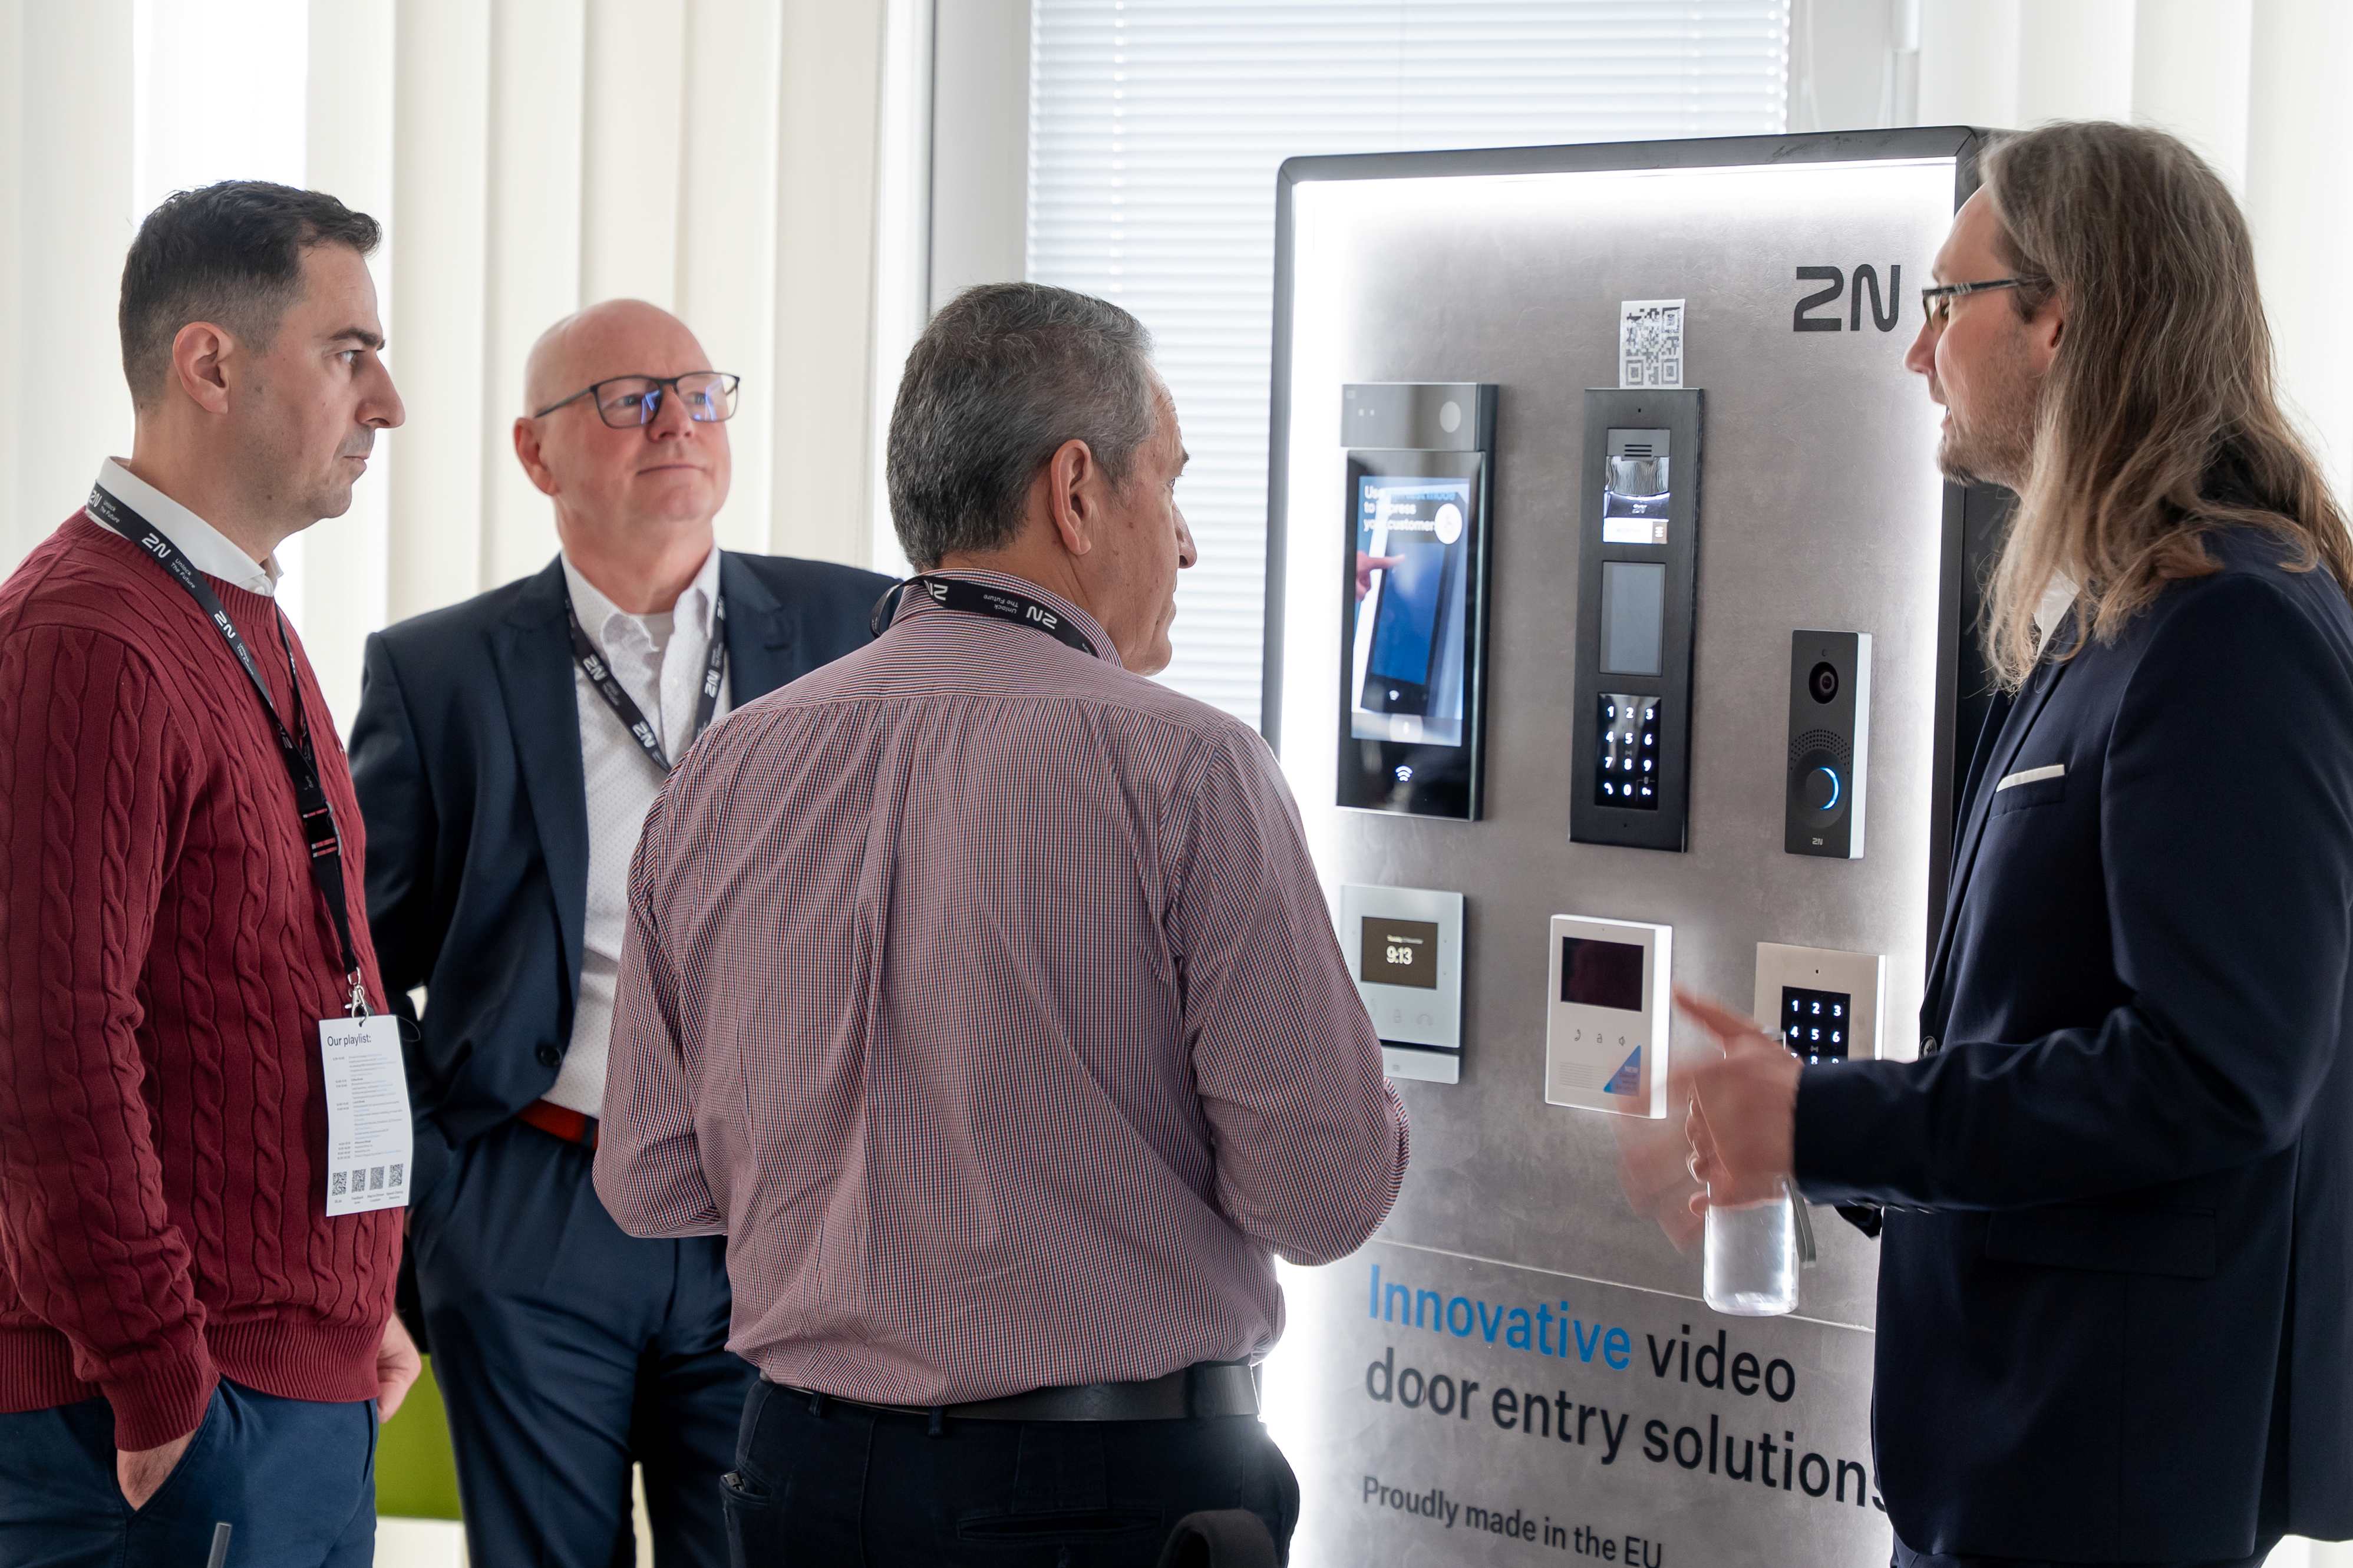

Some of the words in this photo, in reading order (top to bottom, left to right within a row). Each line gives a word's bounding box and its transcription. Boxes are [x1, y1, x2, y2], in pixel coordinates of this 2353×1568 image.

[1793, 263, 1901, 332] 2N
[141, 533, 171, 558] 2N
[170, 562, 180, 573] The
[180, 572, 196, 589] Future
[174, 558, 192, 576] Unlock
[983, 593, 1005, 605] Future
[994, 603, 1018, 614] Unlock
[1006, 598, 1019, 608] The
[213, 610, 236, 639] 2N
[1026, 606, 1058, 630] 2N
[583, 653, 608, 681] 2N
[704, 669, 722, 699] 2N
[1608, 706, 1615, 717] 1
[1626, 707, 1633, 719] 2
[1646, 708, 1654, 719] 3
[632, 722, 655, 748] 2N
[1606, 731, 1614, 742] 4
[1625, 732, 1633, 744] 5
[1644, 734, 1652, 745] 6
[1605, 757, 1613, 768] 7
[1624, 758, 1632, 770] 8
[1644, 760, 1652, 771] 9
[1623, 784, 1631, 795] 0
[1387, 945, 1413, 965] 9:13
[1792, 1000, 1798, 1011] 1
[1813, 1002, 1820, 1014] 2
[1834, 1005, 1842, 1016] 3
[327, 1036, 342, 1047] Our
[344, 1033, 372, 1047] playlist:
[1790, 1026, 1798, 1038] 4
[1811, 1029, 1819, 1040] 5
[1832, 1031, 1840, 1043] 6
[1368, 1263, 1631, 1371] Innovative
[1647, 1324, 1796, 1403] video
[1365, 1347, 1479, 1420] door
[1491, 1387, 1629, 1465] entry
[1363, 1475, 1459, 1529] Proudly
[1466, 1500, 1536, 1540] made
[1544, 1517, 1566, 1549] in
[1573, 1524, 1616, 1559] the
[1625, 1536, 1663, 1568] EU
